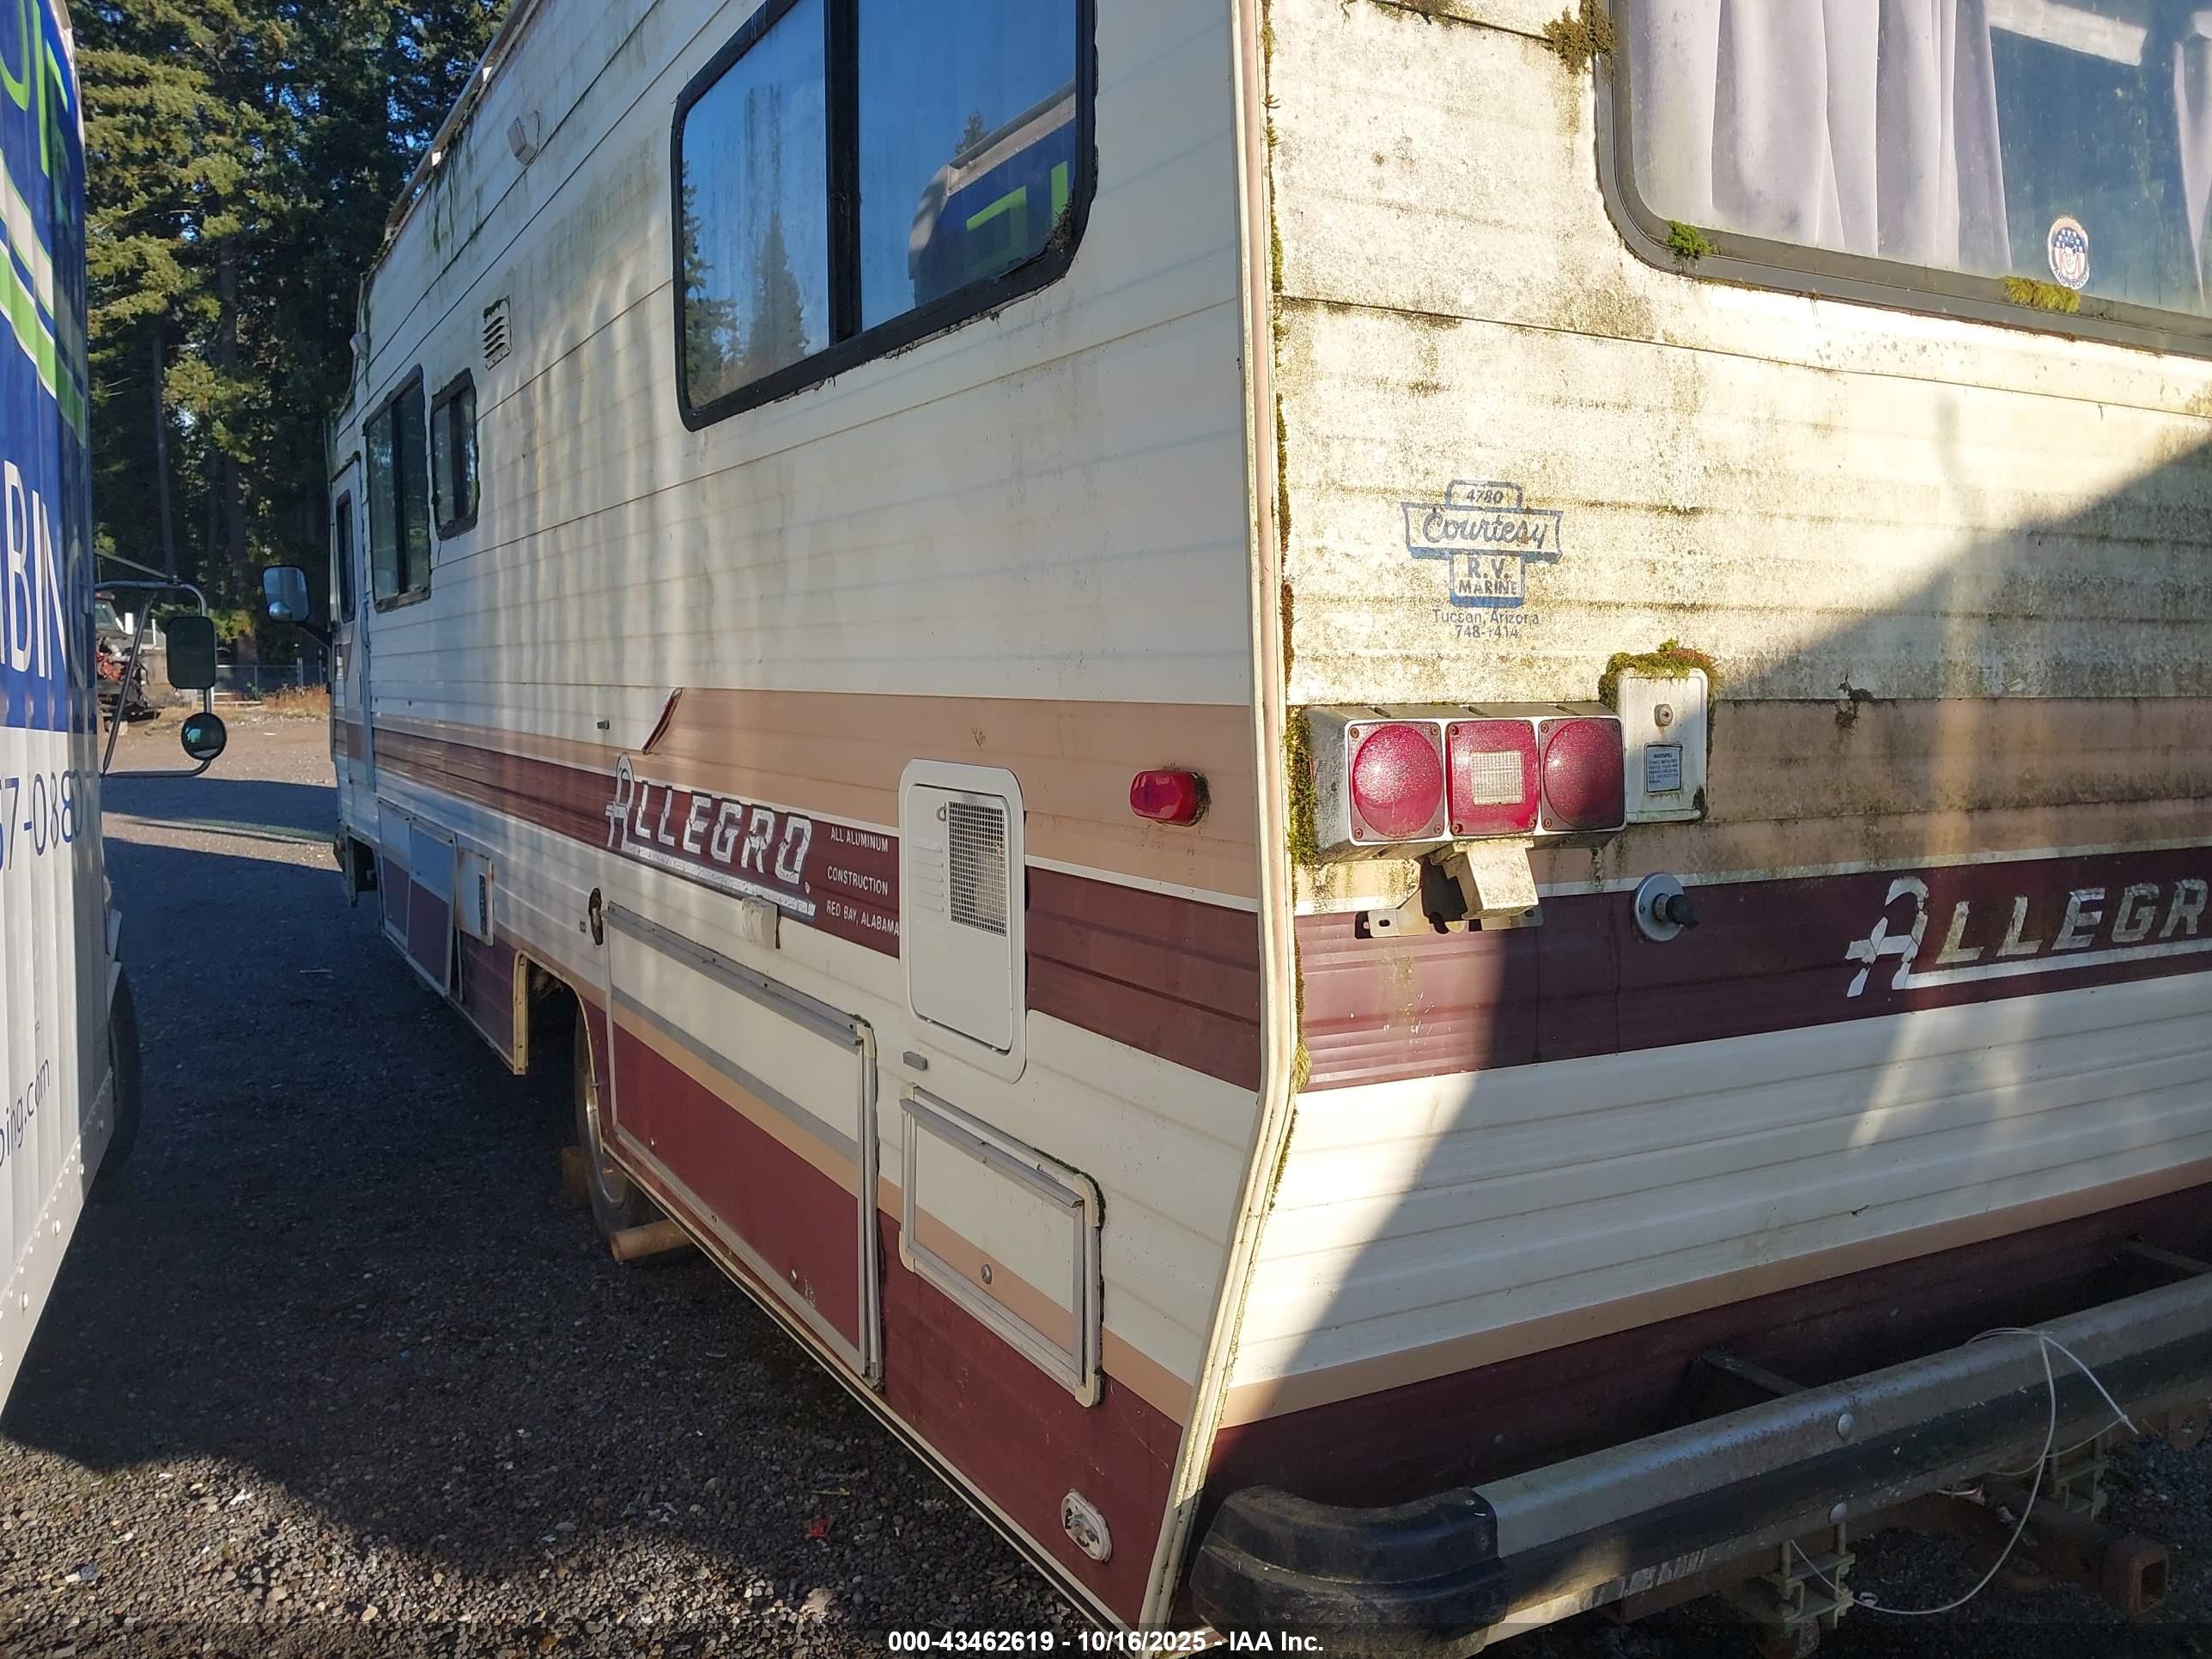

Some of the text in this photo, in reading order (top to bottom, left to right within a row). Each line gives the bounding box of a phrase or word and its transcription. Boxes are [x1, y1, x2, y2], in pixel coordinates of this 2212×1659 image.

[1466, 489, 1504, 504] 4780
[1422, 511, 1548, 550] Courtesy
[0, 460, 88, 690] BING
[1468, 557, 1512, 580] R.V.
[1458, 580, 1518, 595] MARINE
[1490, 608, 1540, 625] Arizona
[605, 752, 813, 885] ALLEGRO
[830, 826, 889, 853] ALL ALUMINUM
[827, 866, 889, 896] CONSTRUCTION
[826, 900, 900, 936] RED BAY, ALABAMA
[1844, 875, 2209, 997] ALLEGR
